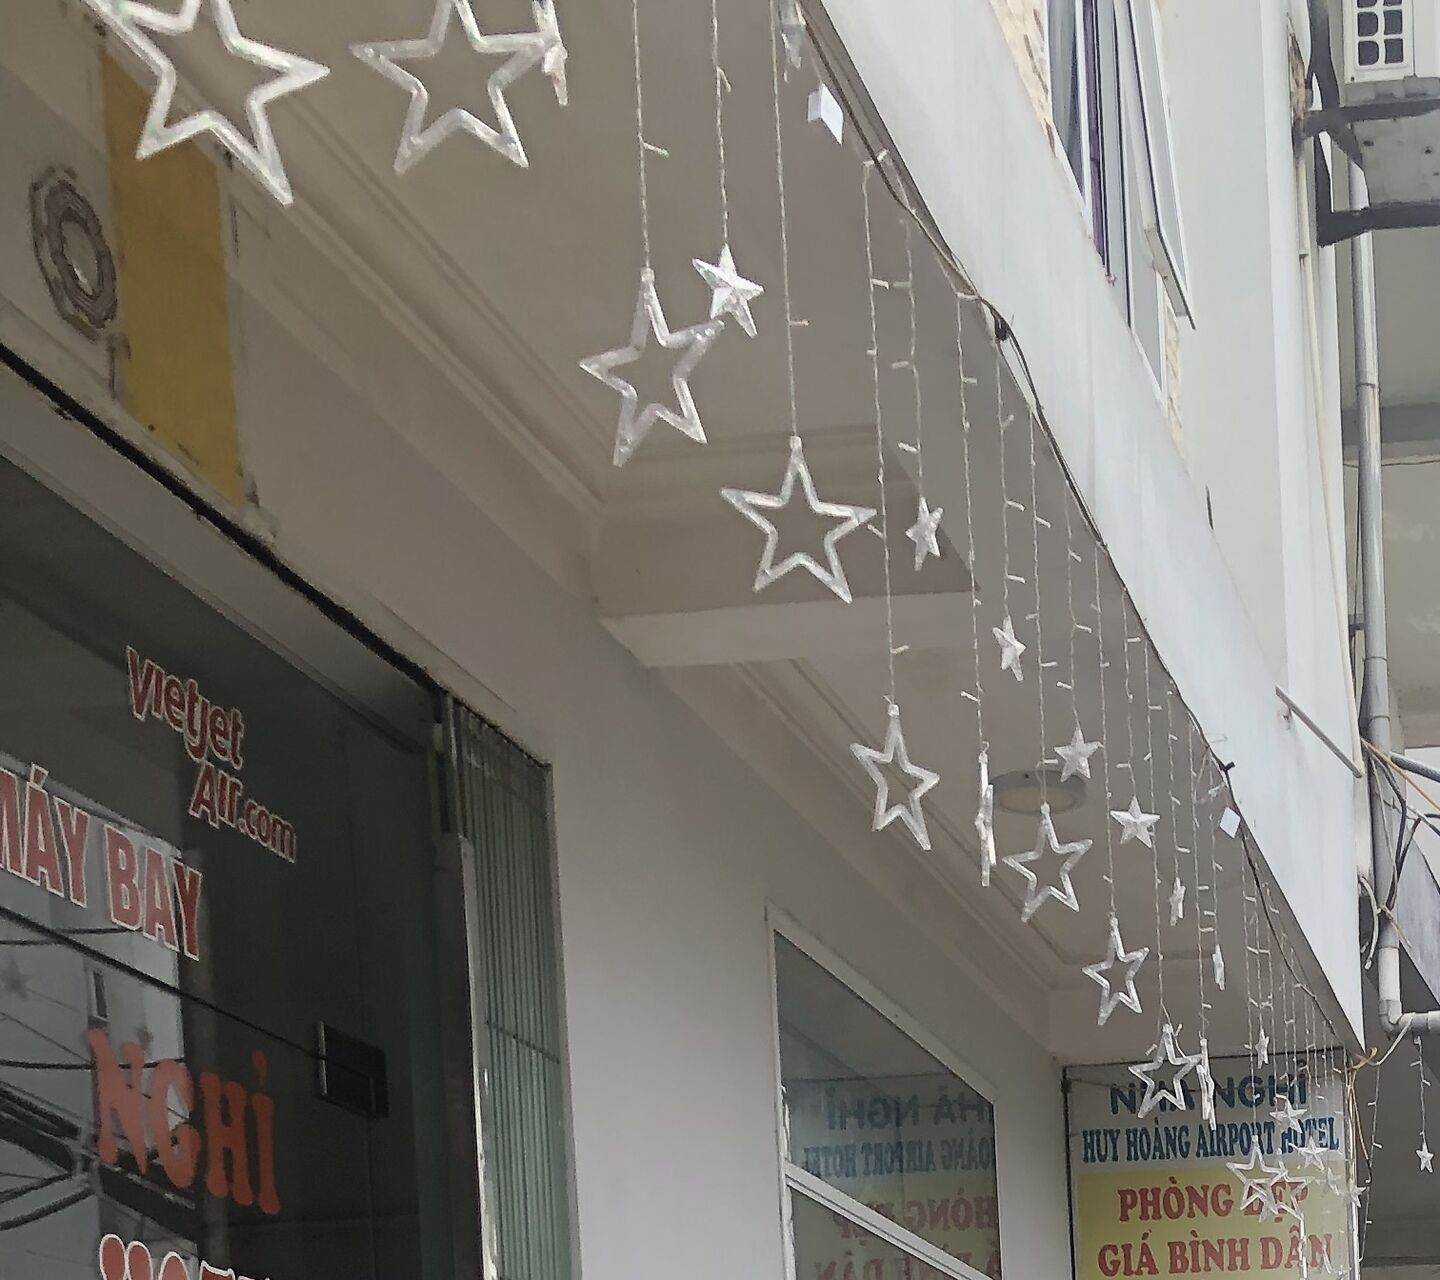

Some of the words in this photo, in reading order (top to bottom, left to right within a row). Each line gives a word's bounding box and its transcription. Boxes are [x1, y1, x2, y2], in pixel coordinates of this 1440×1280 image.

[104, 823, 202, 962] BAY
[1213, 1059, 1307, 1109] NGHỈ
[1083, 1128, 1121, 1164] HUY
[1126, 1117, 1191, 1161] HOÀNG
[1196, 1119, 1275, 1159] AIRPORT
[1281, 1116, 1340, 1156] HOTEL
[1117, 1176, 1234, 1222] PHÒNG
[1097, 1229, 1159, 1277] GIÁ
[1168, 1229, 1250, 1274] BÌNH
[1260, 1225, 1333, 1269] DÂN
